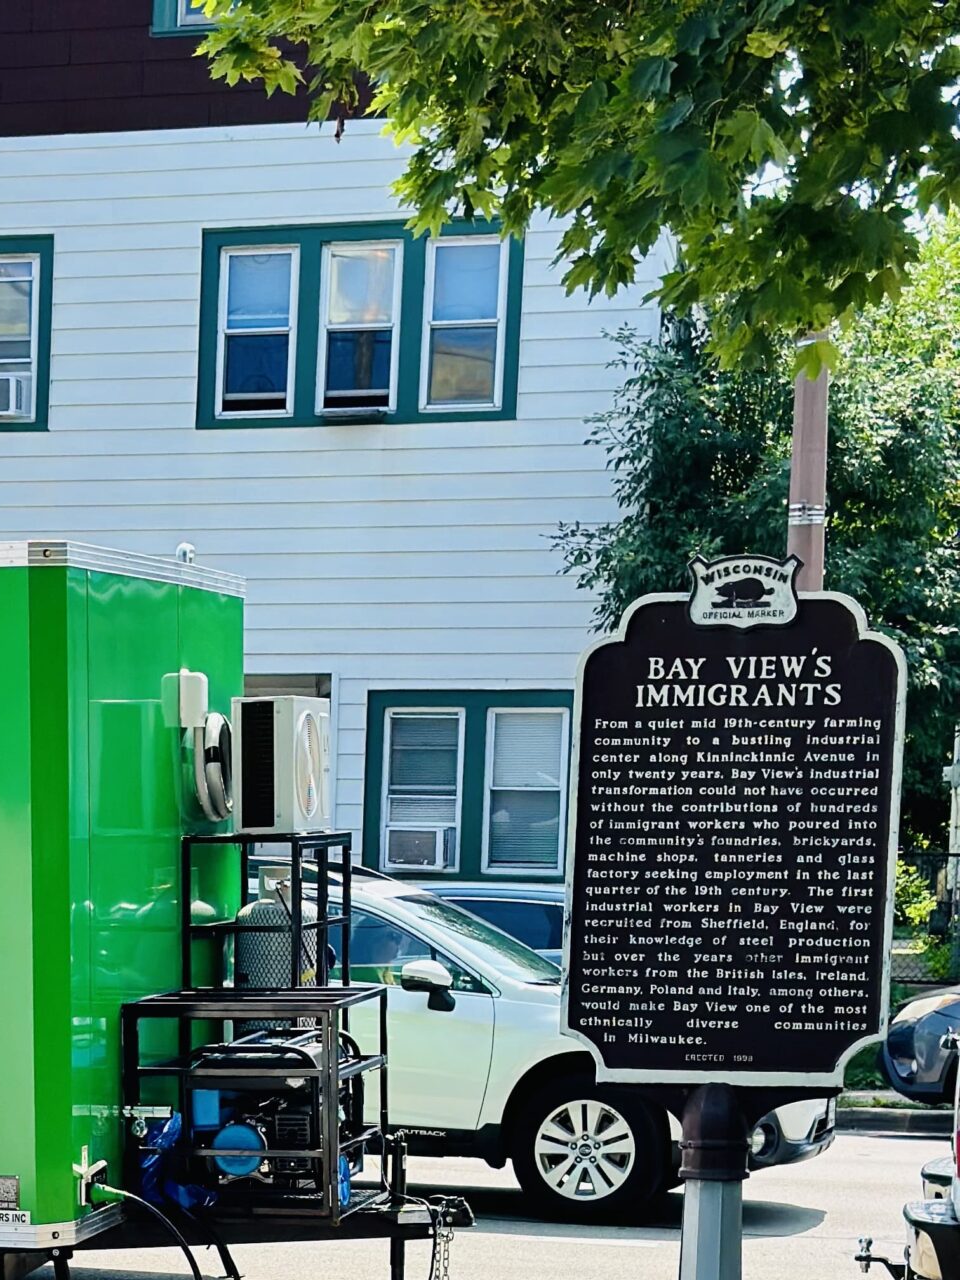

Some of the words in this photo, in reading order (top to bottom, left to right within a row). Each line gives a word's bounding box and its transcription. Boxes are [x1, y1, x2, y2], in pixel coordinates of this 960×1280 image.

[700, 564, 790, 586] WISCONSIN
[702, 611, 742, 619] OFFICIAL
[748, 610, 784, 619] MARKER
[648, 657, 706, 679] BAY
[726, 648, 831, 679] VIEW'S
[636, 684, 841, 707] IMMIGRANTS
[595, 719, 627, 728] From
[648, 718, 684, 730] quiet
[691, 718, 716, 728] mid
[724, 718, 815, 729] 19th-century
[824, 717, 881, 730] farming
[594, 736, 671, 747] community
[686, 736, 700, 745] to
[712, 737, 719, 745] a
[732, 735, 791, 747] bustling
[807, 734, 880, 744] industrial
[593, 753, 639, 762] center
[650, 753, 688, 765] along
[697, 752, 794, 762] Kinninckinnic
[804, 752, 855, 761] Avenue
[866, 752, 879, 761] in
[592, 769, 621, 780] only
[629, 770, 675, 781] twenty
[731, 769, 756, 780] Bay
[761, 766, 803, 779] View's
[810, 769, 879, 779] industrial
[592, 785, 692, 795] transformation
[699, 785, 736, 795] could
[744, 786, 766, 795] not
[771, 785, 803, 795] have
[811, 786, 878, 796] occurred
[591, 802, 644, 812] without
[652, 803, 673, 812] the
[682, 802, 777, 812] contributions
[787, 802, 801, 812] of
[811, 803, 877, 812] hundreds
[590, 819, 603, 829] of
[610, 820, 680, 831] immigrant
[688, 819, 745, 829] workers
[753, 819, 779, 829] who
[789, 820, 839, 831] poured
[849, 819, 877, 829] into
[590, 836, 611, 845] the
[620, 834, 704, 847] community's
[588, 852, 646, 861] machine
[714, 853, 782, 862] tanneries
[797, 853, 822, 863] and
[838, 853, 874, 866] glass
[587, 869, 639, 880] factory
[645, 869, 697, 882] seeking
[705, 869, 788, 881] employment
[796, 870, 809, 879] in
[817, 870, 840, 879] the
[847, 870, 874, 880] last
[586, 886, 640, 896] quarter
[646, 885, 660, 895] of
[665, 885, 687, 895] the
[695, 885, 721, 895] 19th
[731, 886, 790, 897] century.
[808, 886, 833, 896] The
[842, 887, 873, 896] first
[586, 901, 652, 911] industrial
[664, 902, 719, 912] workers
[729, 903, 741, 912] in
[754, 903, 779, 914] Bay
[791, 903, 824, 913] View
[837, 906, 872, 914] were
[585, 918, 651, 927] recruited
[660, 918, 691, 928] from
[701, 918, 768, 929] Sheffield,
[850, 920, 870, 930] for
[584, 935, 618, 944] their
[630, 934, 702, 947] knowledge
[713, 936, 727, 945] of
[739, 936, 773, 946] steel
[789, 937, 870, 947] production
[583, 951, 604, 960] but
[657, 952, 680, 961] the
[694, 954, 732, 963] years
[747, 953, 783, 962] other
[795, 953, 869, 966] immigrant
[583, 967, 638, 977] workers
[646, 968, 677, 977] from
[687, 968, 708, 978] the
[716, 969, 764, 979] British
[582, 984, 642, 995] Germany,
[650, 985, 693, 994] Poland
[698, 986, 721, 995] and
[770, 988, 813, 999] among
[581, 1001, 619, 1010] would
[629, 1001, 664, 1010] make
[673, 1001, 698, 1012] Bay
[706, 1002, 737, 1011] View
[779, 1003, 793, 1013] of
[801, 1003, 824, 1013] the
[834, 1005, 866, 1014] most
[580, 1017, 652, 1028] ethnically
[687, 1019, 738, 1028] diverse
[774, 1021, 866, 1030] communities
[604, 1033, 615, 1042] in
[629, 1034, 706, 1044] Milwaukee.
[399, 1128, 446, 1137] OUTBACK
[12, 1213, 26, 1223] INC
